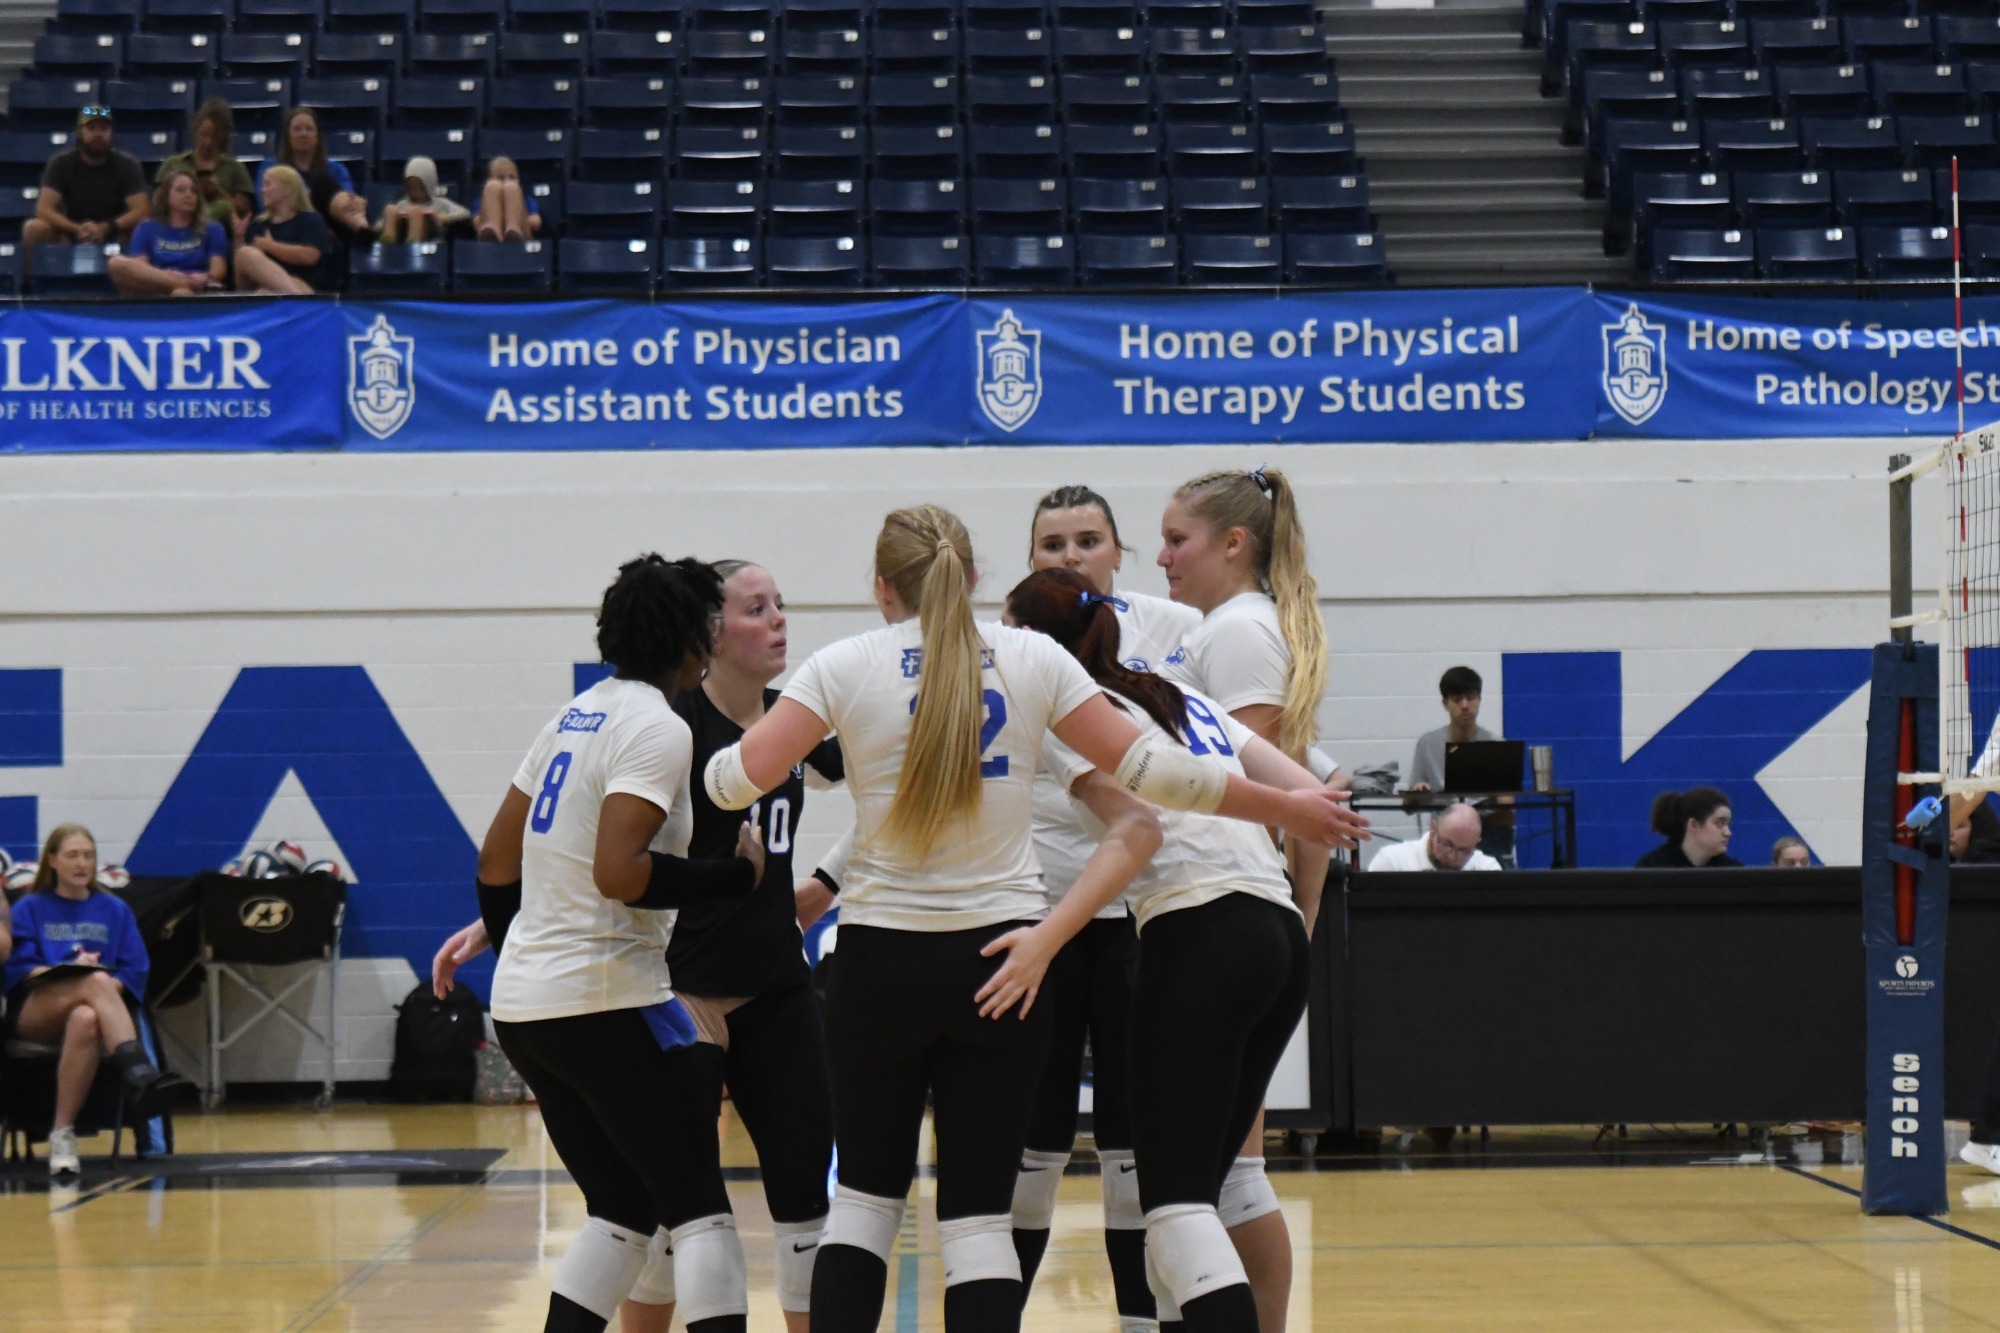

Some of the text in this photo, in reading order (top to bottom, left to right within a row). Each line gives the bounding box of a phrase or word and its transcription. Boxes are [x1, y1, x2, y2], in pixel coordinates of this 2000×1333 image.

[489, 327, 901, 375] Home of Physician
[1120, 315, 1519, 367] Home of Physical
[1688, 319, 2000, 358] Home of Speech
[1, 336, 271, 391] LKNER
[0, 400, 272, 420] F HEALTH SCIENCES
[486, 383, 904, 423] Assistant Students
[1114, 373, 1525, 425] Therapy Students
[1756, 371, 1952, 415] Pathology
[1126, 750, 1154, 788] Tandem
[531, 751, 573, 834] 8
